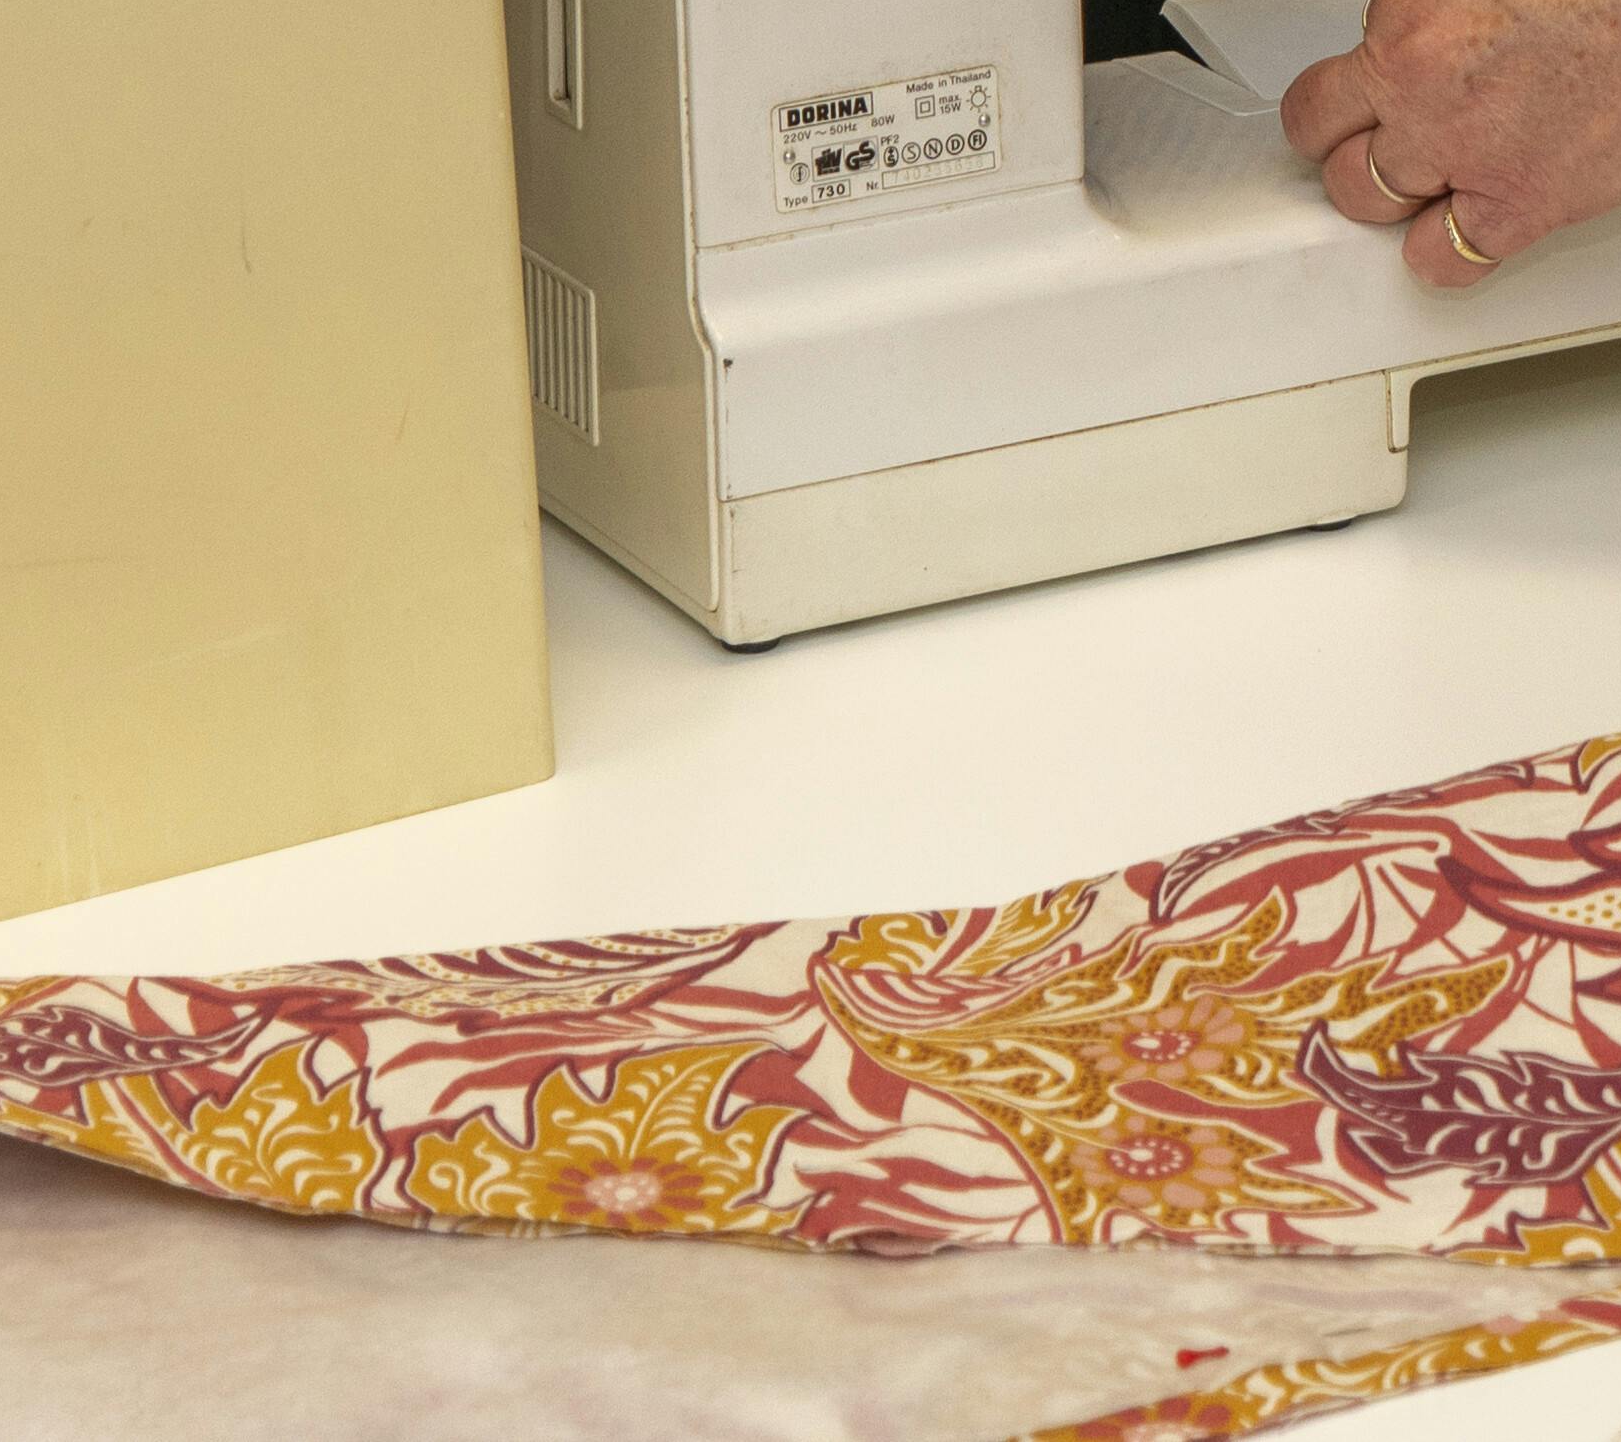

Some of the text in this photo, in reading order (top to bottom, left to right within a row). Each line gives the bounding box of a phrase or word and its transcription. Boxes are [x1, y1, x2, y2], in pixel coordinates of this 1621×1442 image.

[906, 70, 992, 94] Made in Thailand
[787, 97, 868, 127] DORINA
[939, 102, 962, 114] 15W
[783, 130, 812, 144] 220V
[829, 122, 858, 136] 50Hz
[870, 114, 896, 127] 80W
[880, 134, 899, 146] PF2
[845, 139, 875, 171] GS
[783, 183, 846, 209] Type 730
